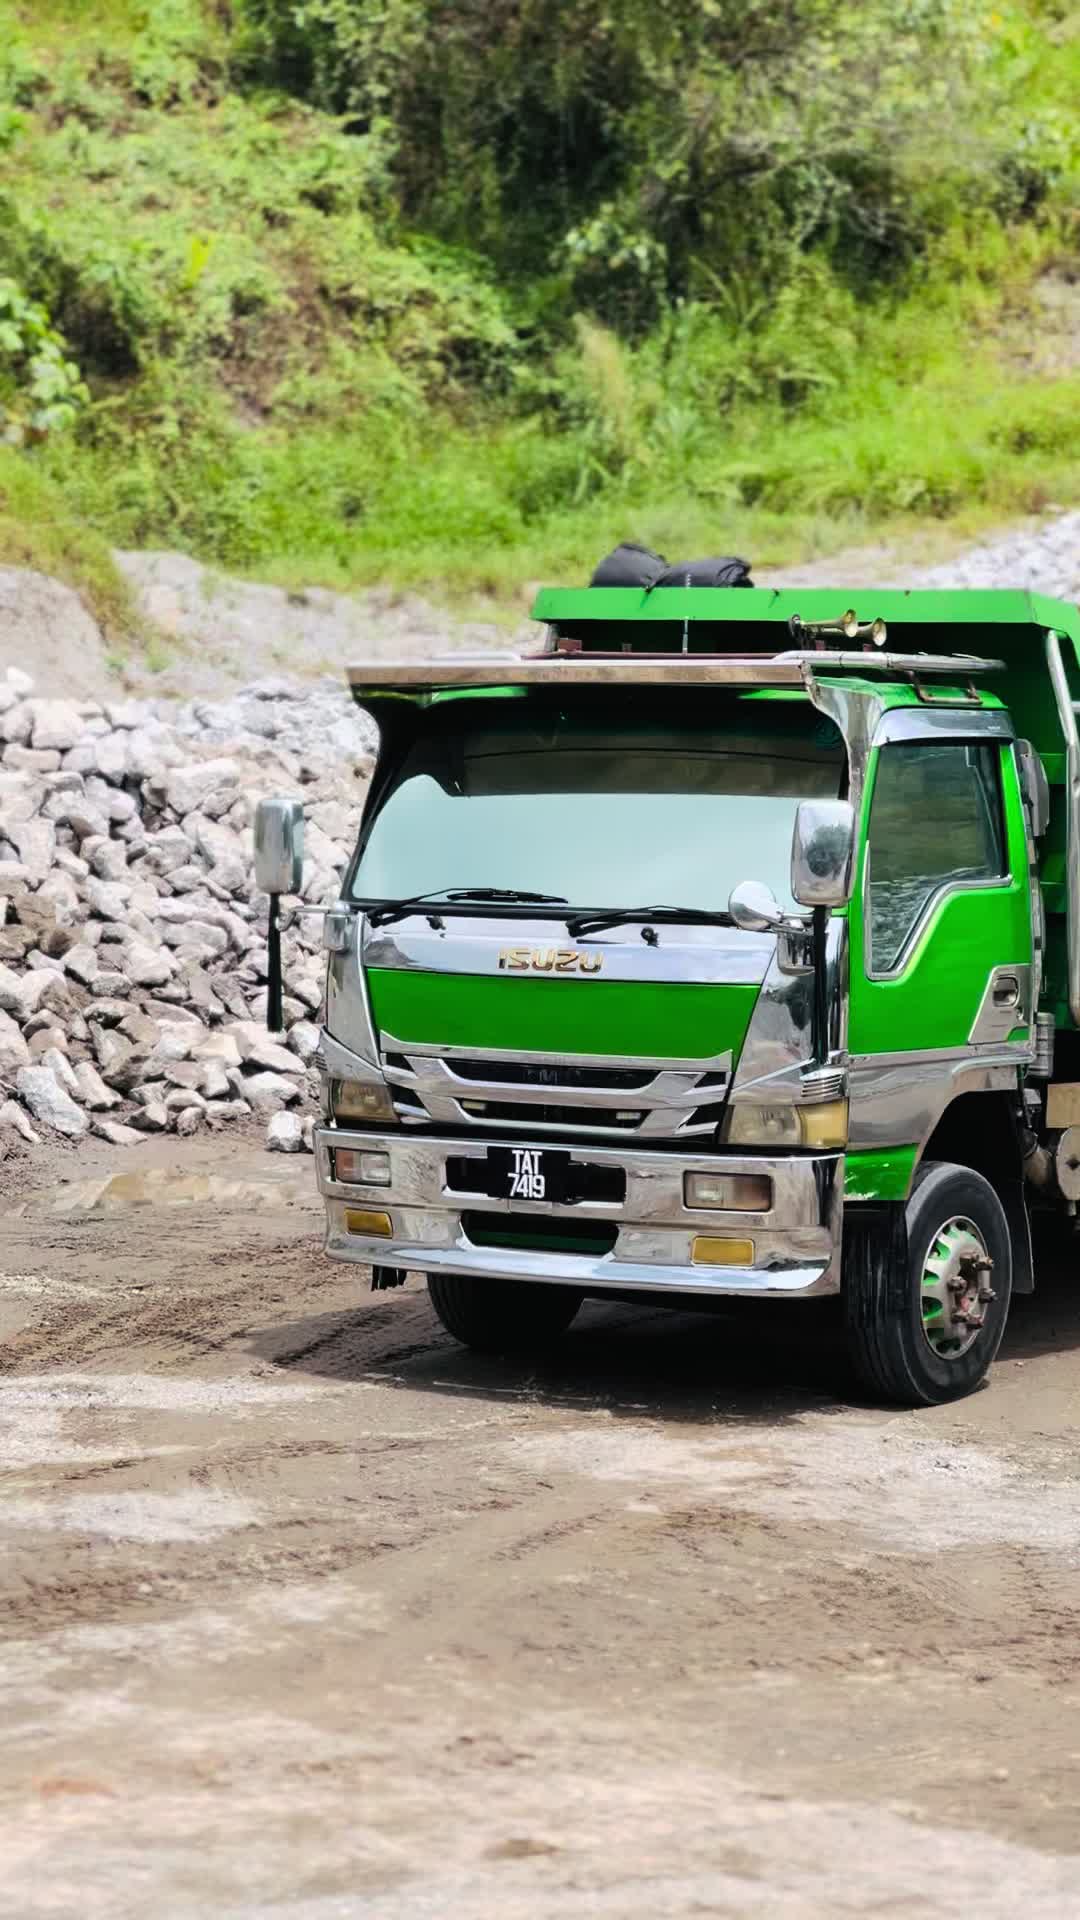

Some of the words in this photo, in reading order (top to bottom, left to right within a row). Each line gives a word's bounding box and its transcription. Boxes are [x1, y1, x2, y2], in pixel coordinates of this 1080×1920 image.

[498, 947, 603, 973] ISUZU
[512, 1150, 543, 1175] TAT
[507, 1173, 545, 1198] 7419
